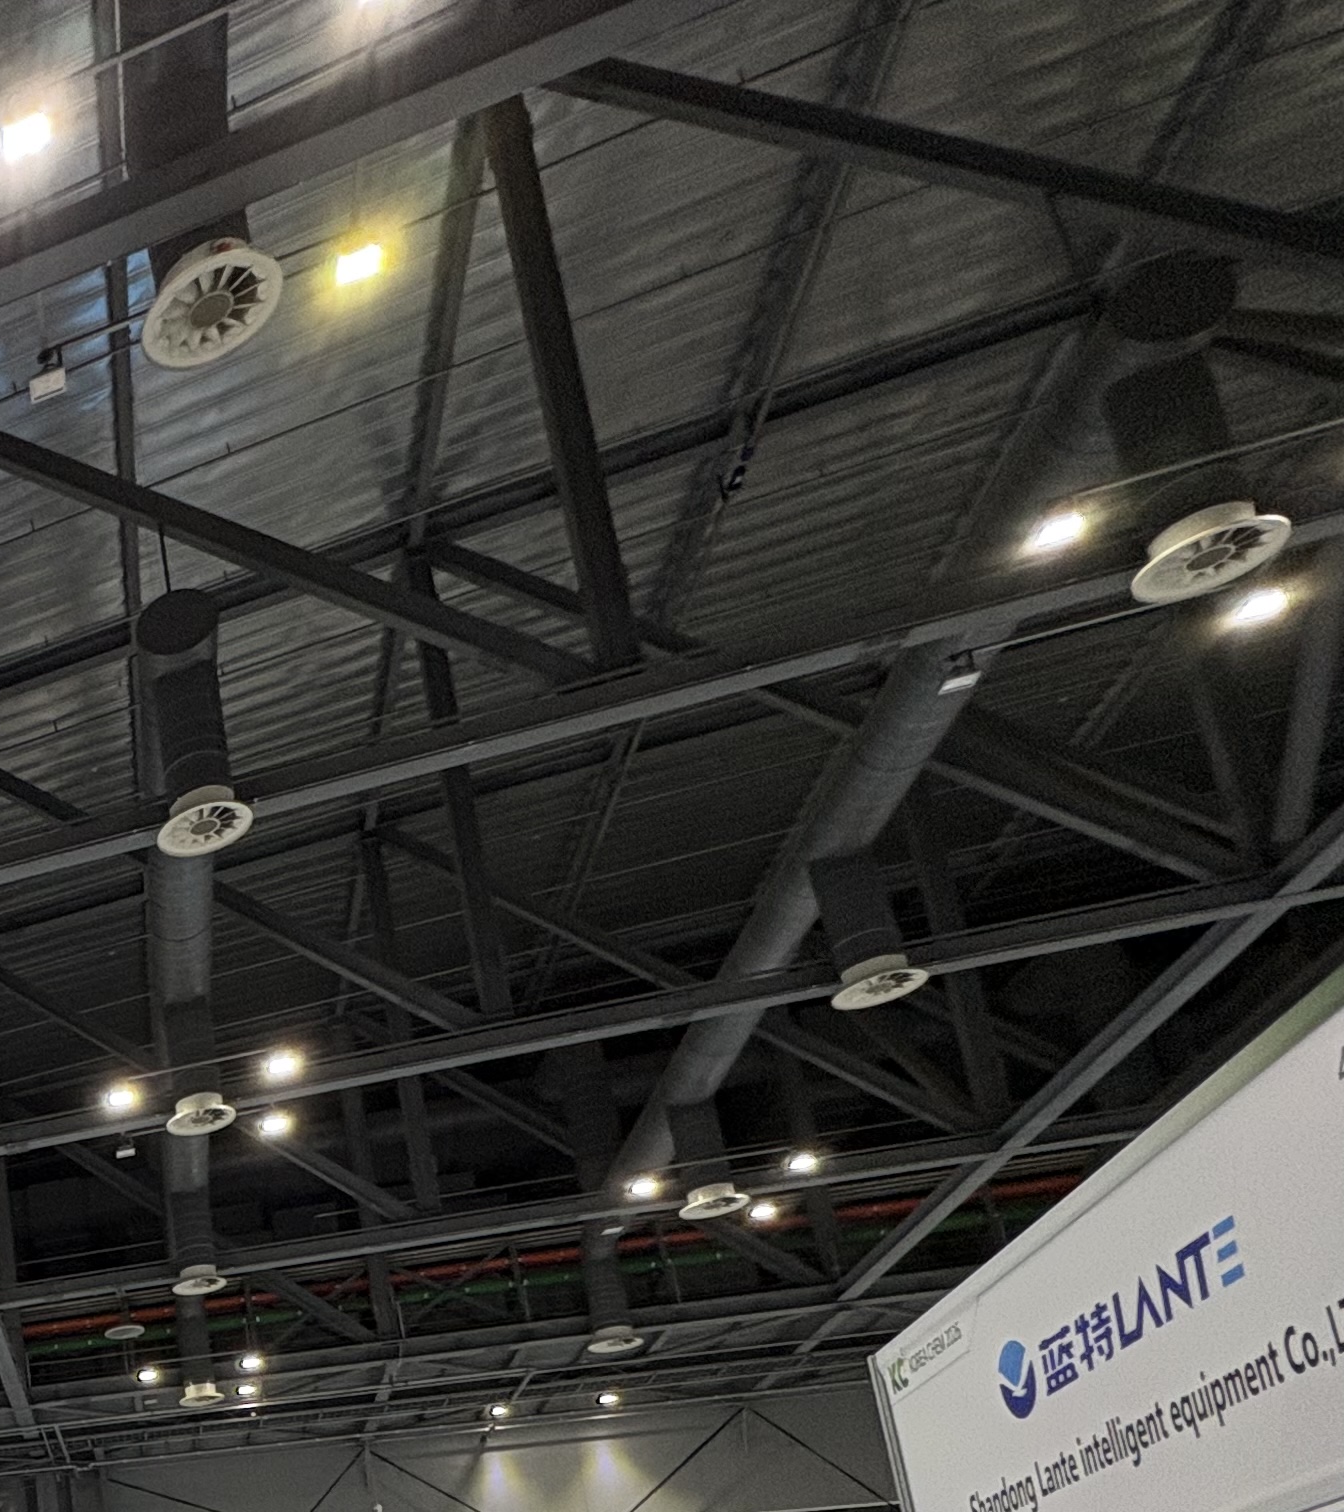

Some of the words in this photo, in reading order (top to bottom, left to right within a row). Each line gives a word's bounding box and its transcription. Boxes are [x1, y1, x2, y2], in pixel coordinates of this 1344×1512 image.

[1034, 1451, 1080, 1497] Lante
[1076, 1402, 1170, 1477] intelligent
[1170, 1341, 1285, 1438] equipment
[1284, 1298, 1344, 1374] Co.,L
